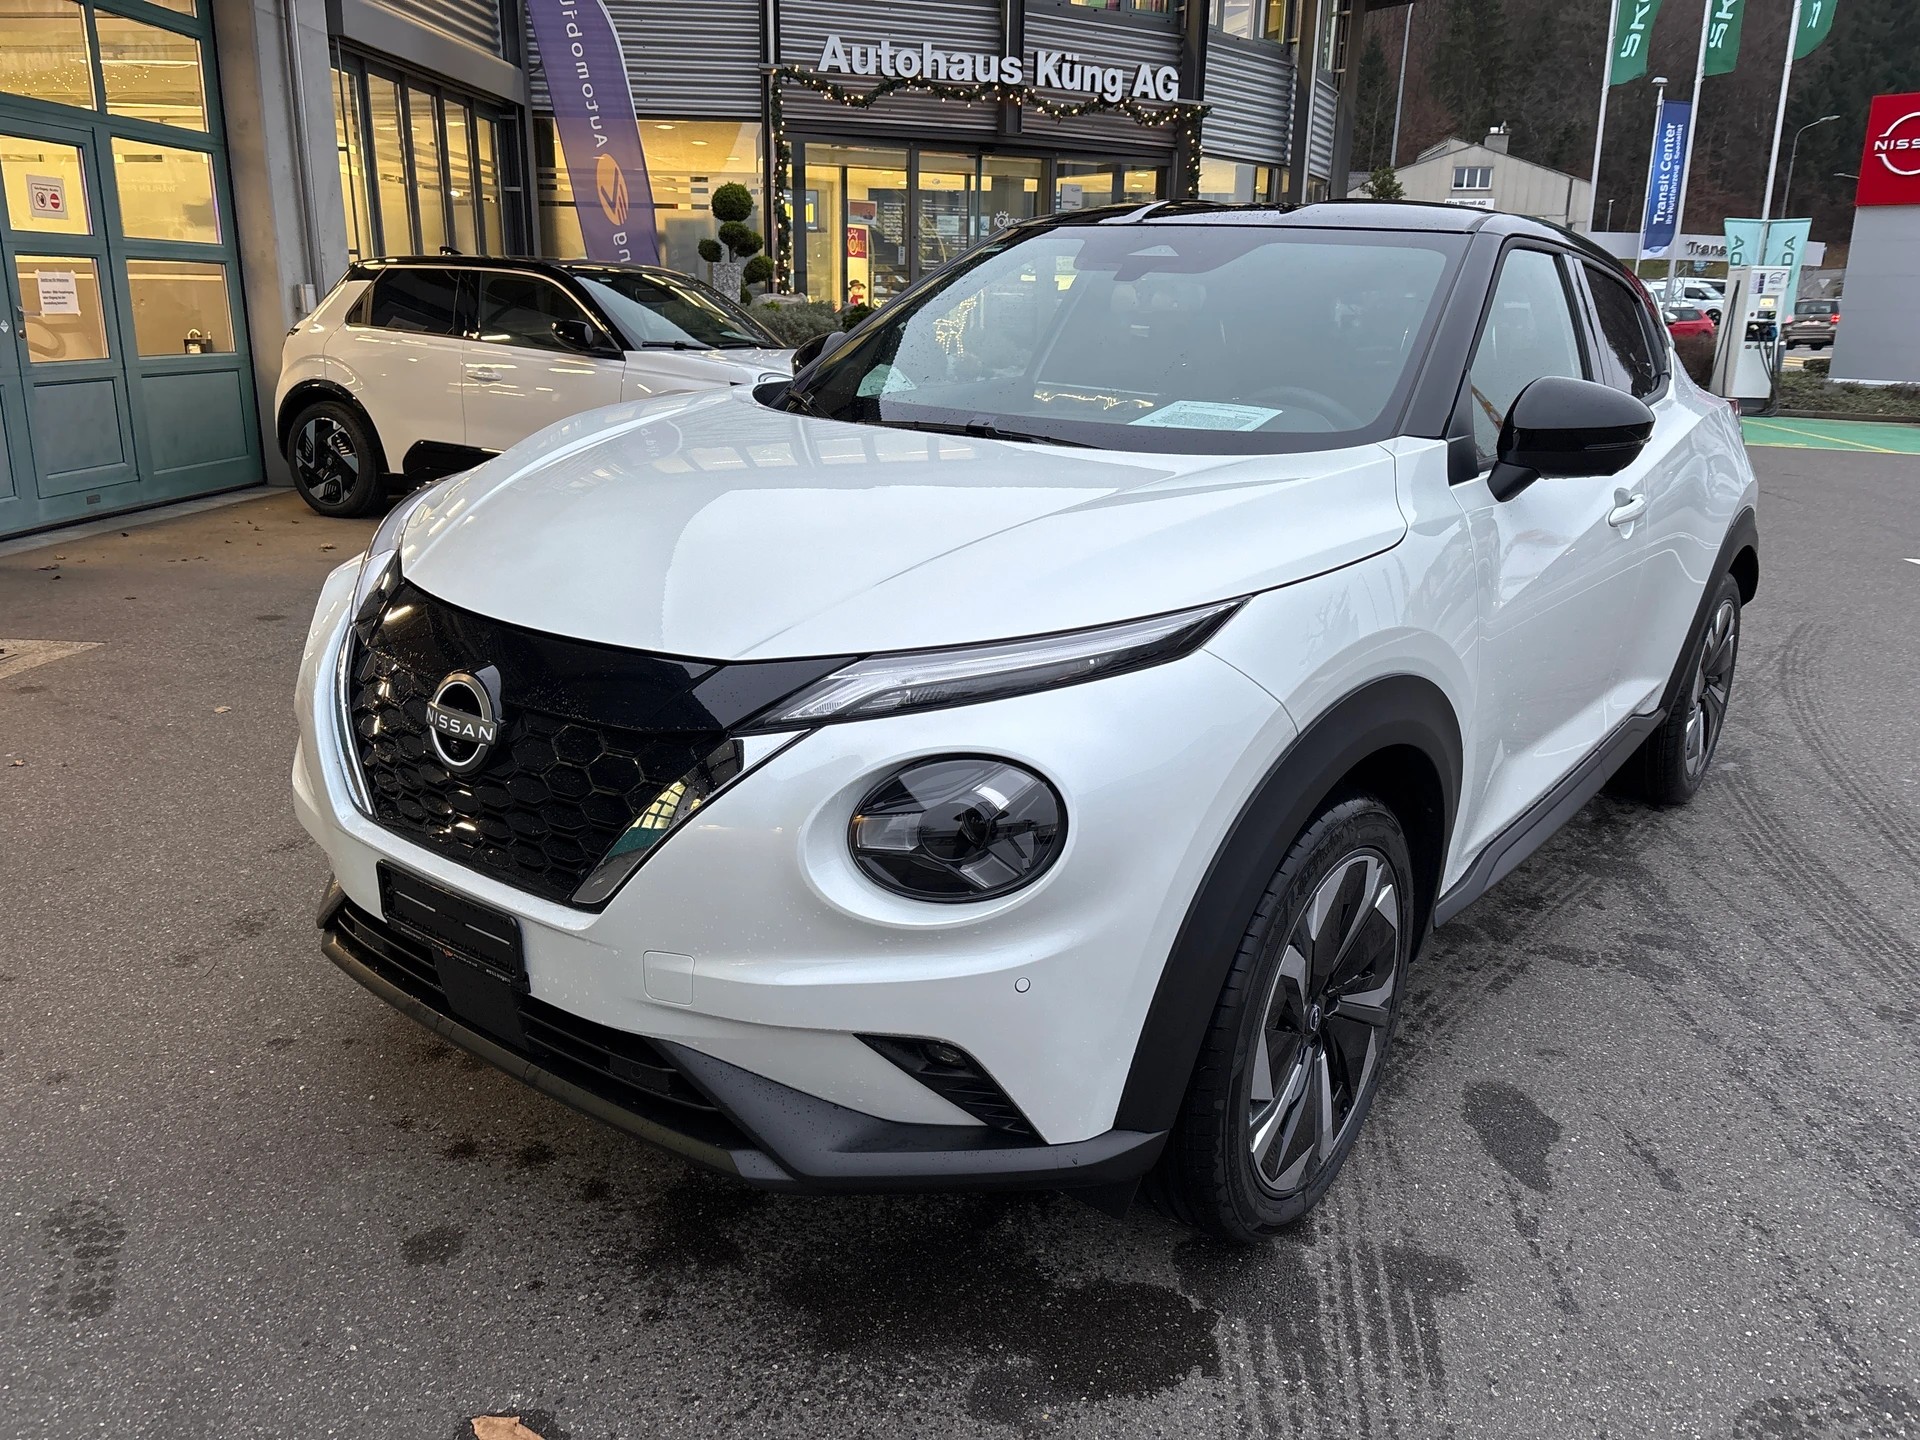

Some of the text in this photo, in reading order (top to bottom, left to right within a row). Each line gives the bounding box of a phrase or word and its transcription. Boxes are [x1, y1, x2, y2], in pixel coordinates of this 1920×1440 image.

[1620, 0, 1651, 58] SK
[817, 34, 1180, 102] Autohaus Küng AG
[1652, 122, 1676, 225] Transit Center
[1873, 138, 1920, 151] NISS
[425, 706, 494, 741] NISSAN
